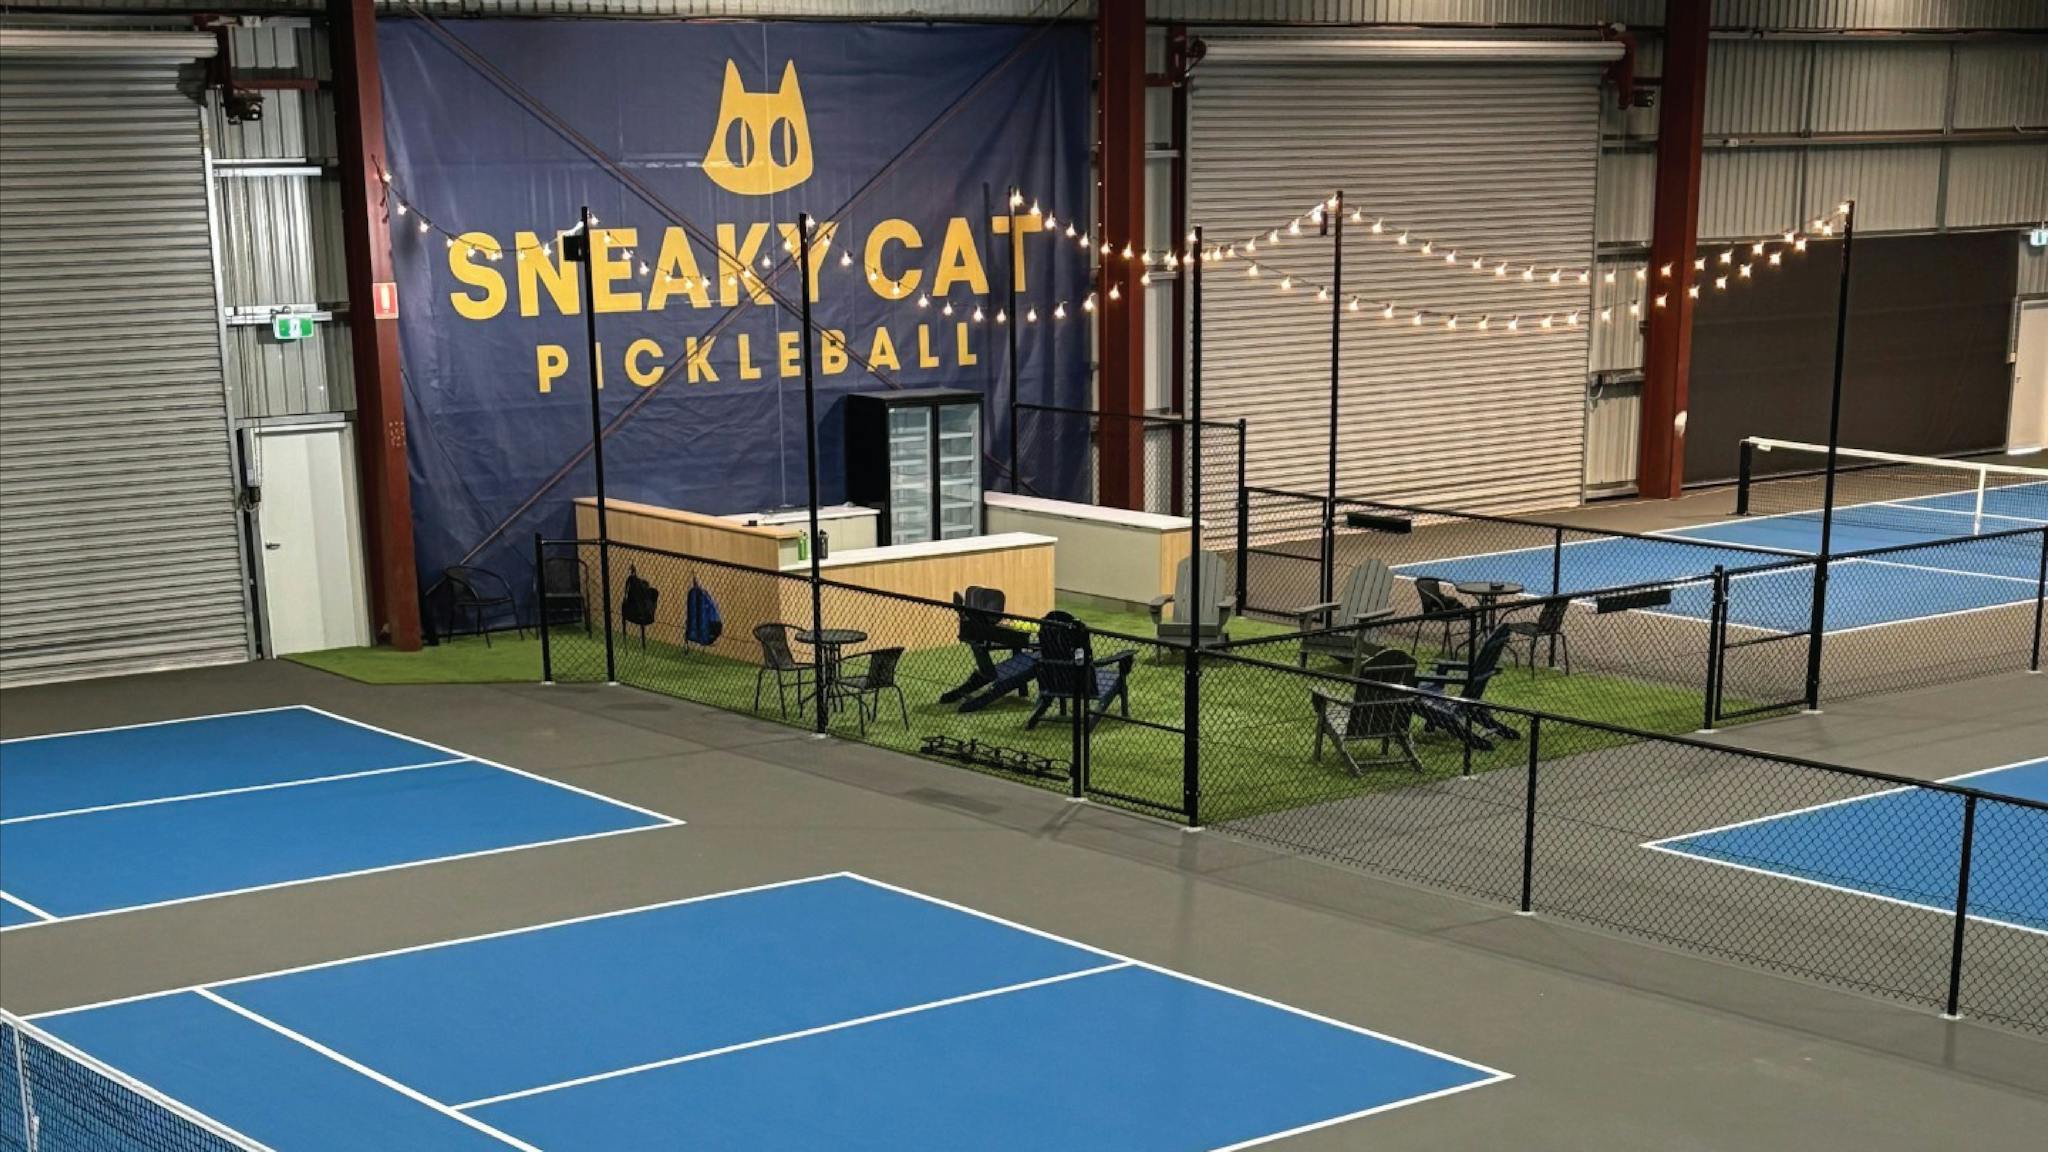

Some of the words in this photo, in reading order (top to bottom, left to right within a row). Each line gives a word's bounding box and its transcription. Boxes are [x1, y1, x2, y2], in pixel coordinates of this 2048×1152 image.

[449, 221, 837, 320] SNEAKY
[864, 213, 1044, 301] CAT
[537, 322, 978, 393] PICKLEBALL
